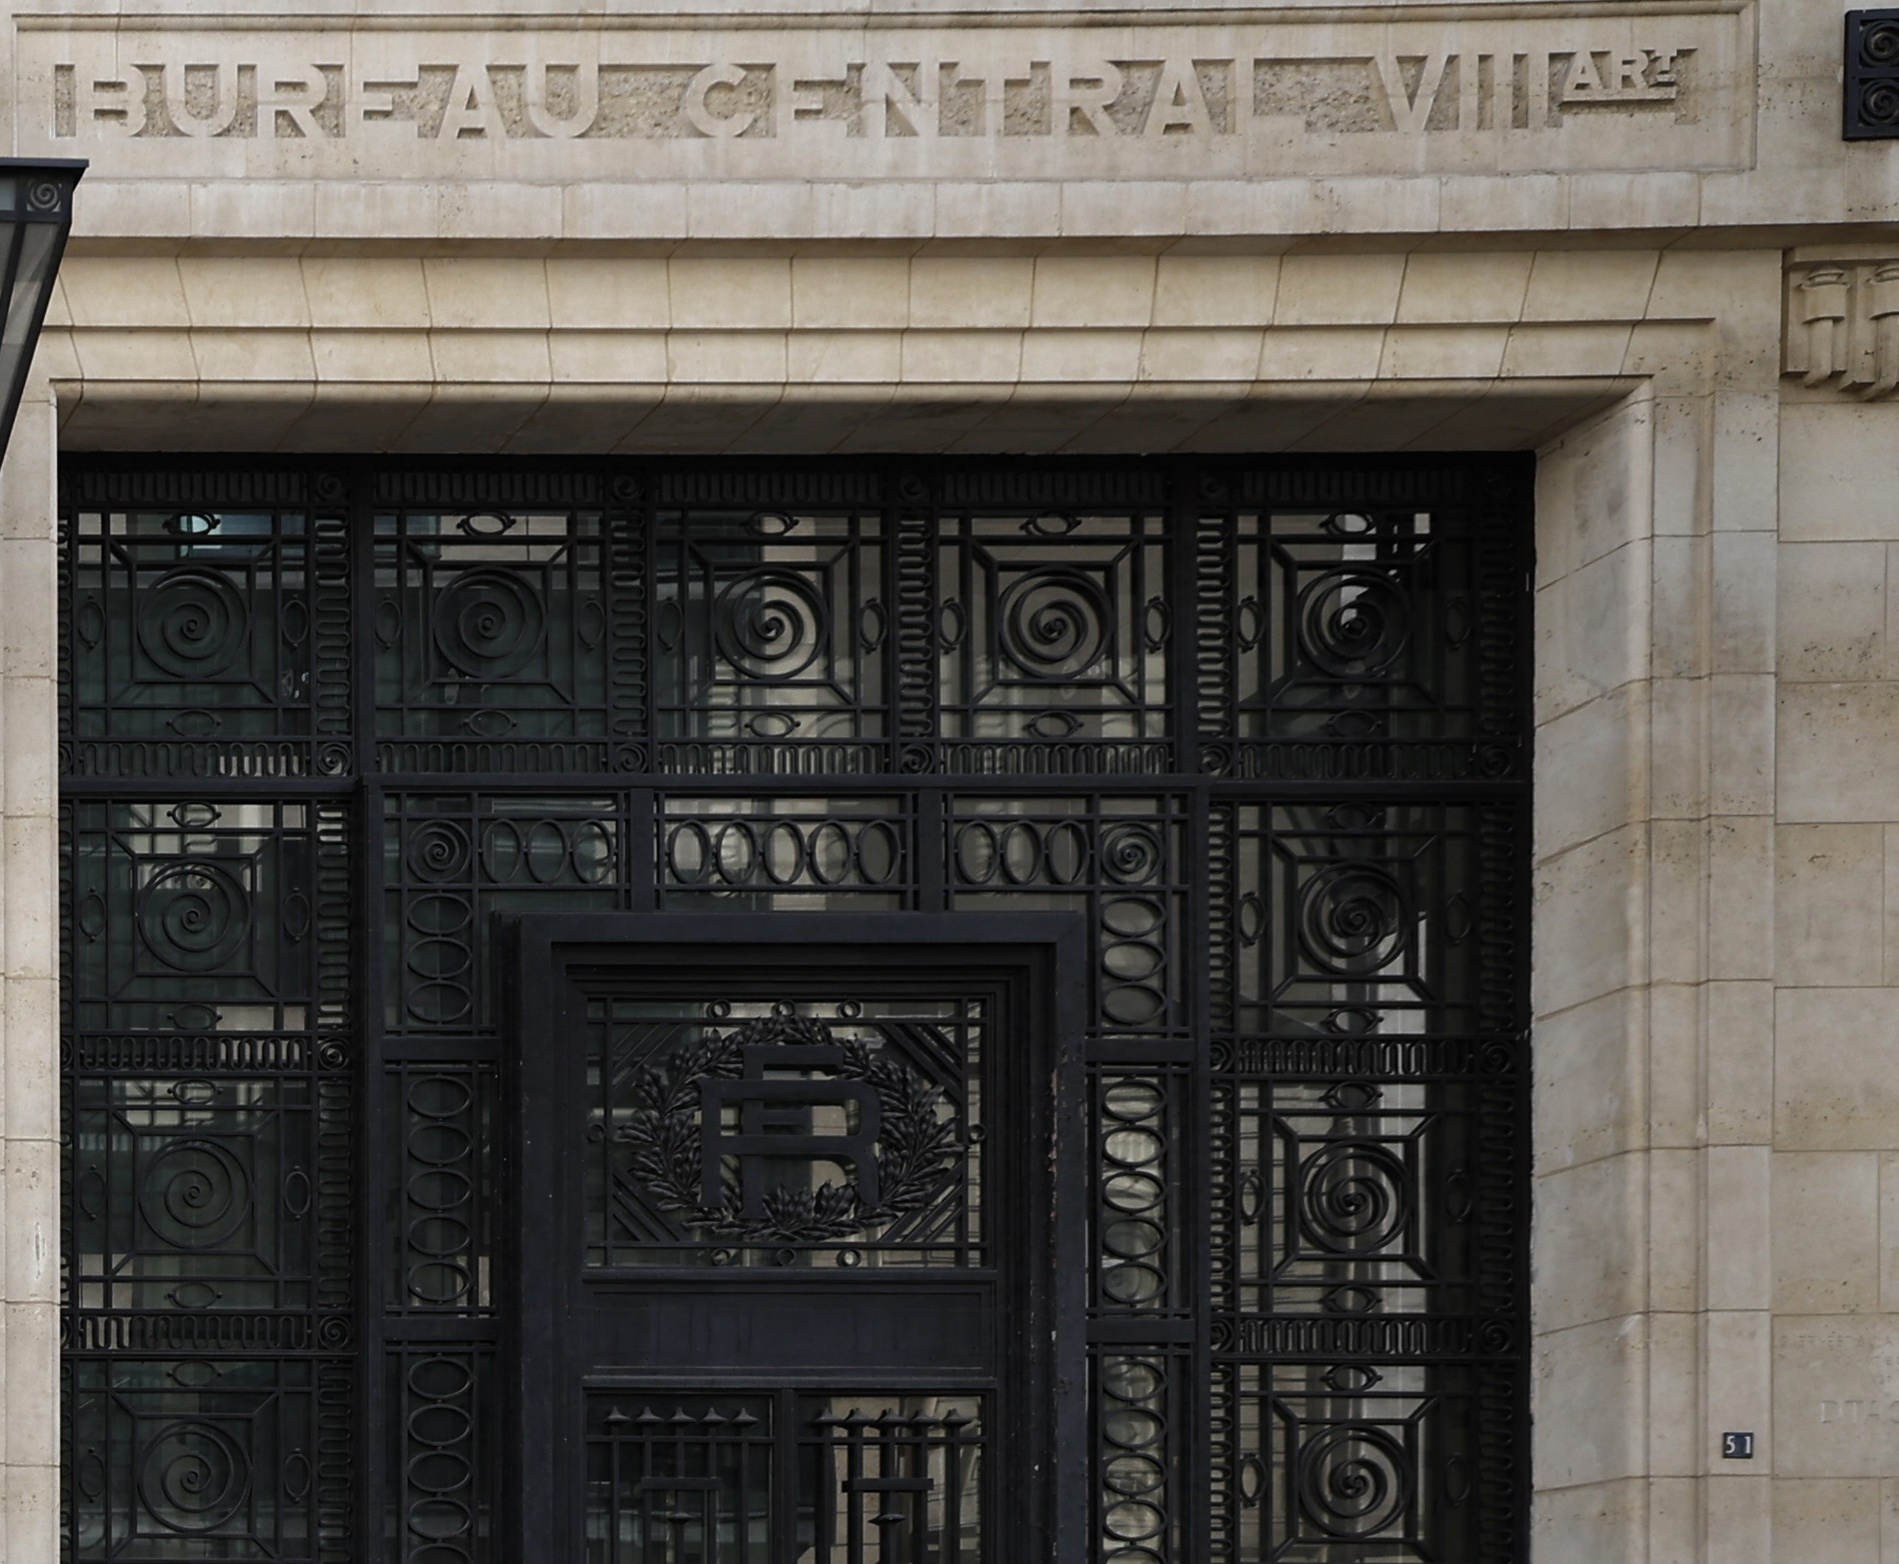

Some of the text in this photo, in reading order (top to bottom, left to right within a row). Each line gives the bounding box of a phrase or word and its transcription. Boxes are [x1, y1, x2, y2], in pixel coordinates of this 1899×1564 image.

[73, 62, 601, 138] BUREAU
[684, 58, 1306, 138] CENTRAL
[1724, 1435, 1752, 1454] 51
